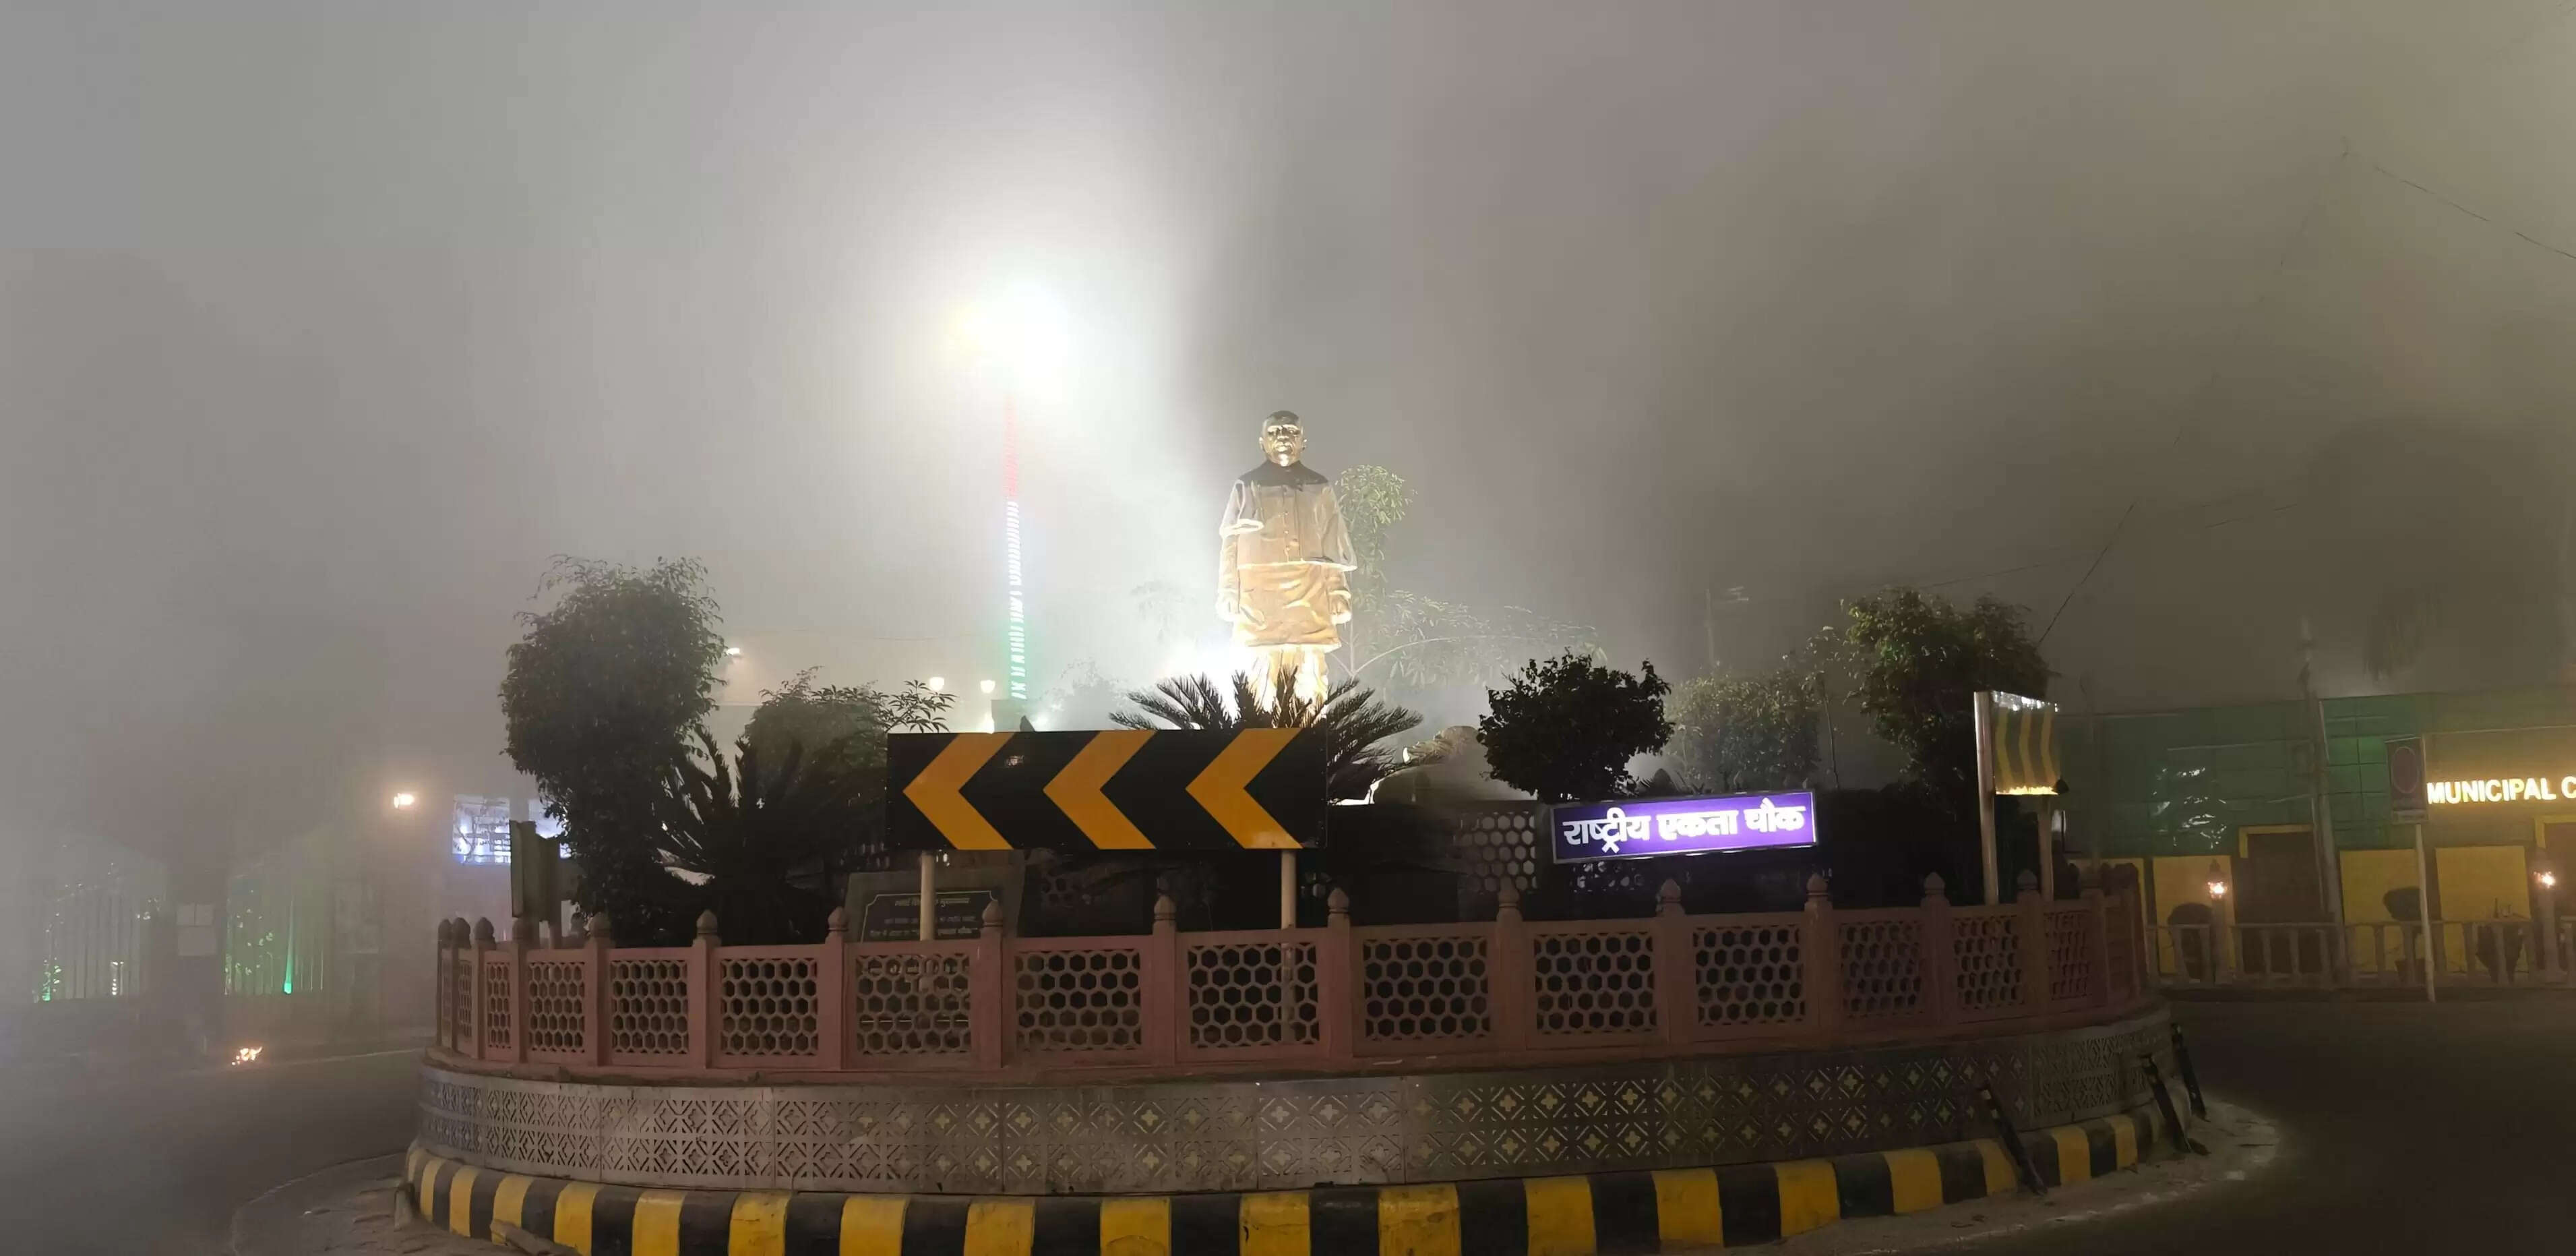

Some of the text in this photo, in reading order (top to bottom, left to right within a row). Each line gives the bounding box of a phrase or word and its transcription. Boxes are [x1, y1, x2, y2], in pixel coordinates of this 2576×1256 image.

[2426, 778, 2556, 804] MUNICIPAL
[1562, 798, 1806, 854] राष्ट्रीय एकता चौक
